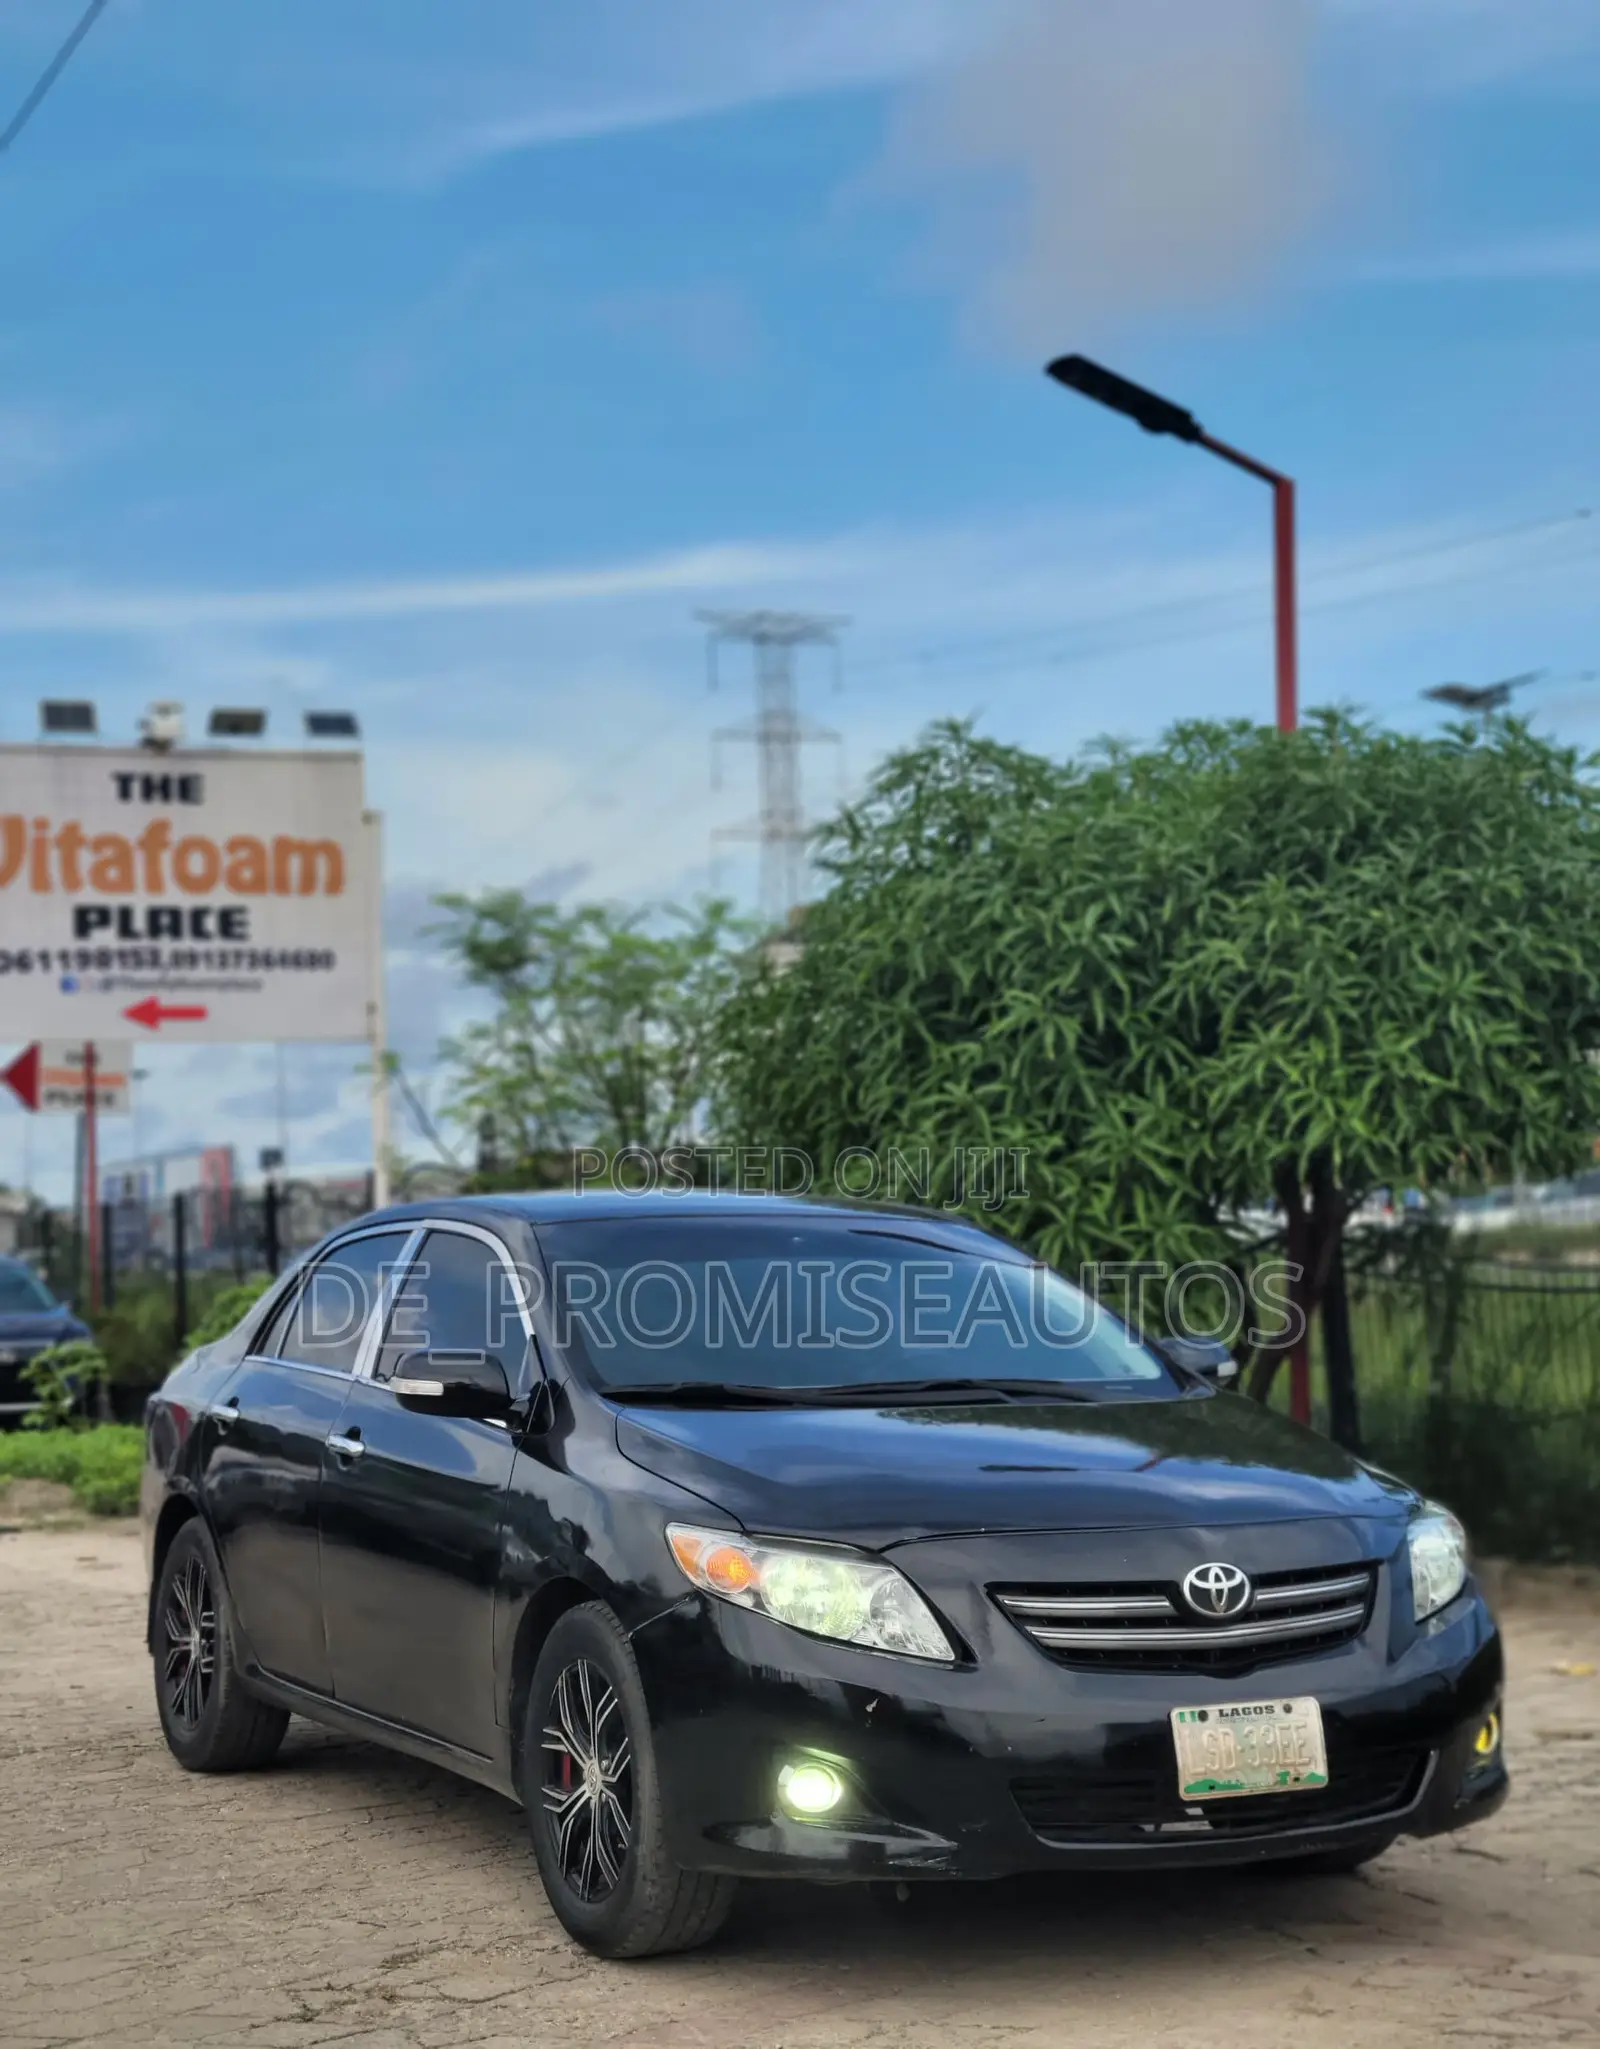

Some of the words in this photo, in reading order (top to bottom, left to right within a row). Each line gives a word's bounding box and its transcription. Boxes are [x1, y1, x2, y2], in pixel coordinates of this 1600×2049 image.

[112, 771, 205, 805] THE
[73, 904, 251, 942] PLACE
[1218, 1704, 1276, 1718] LAGOS
